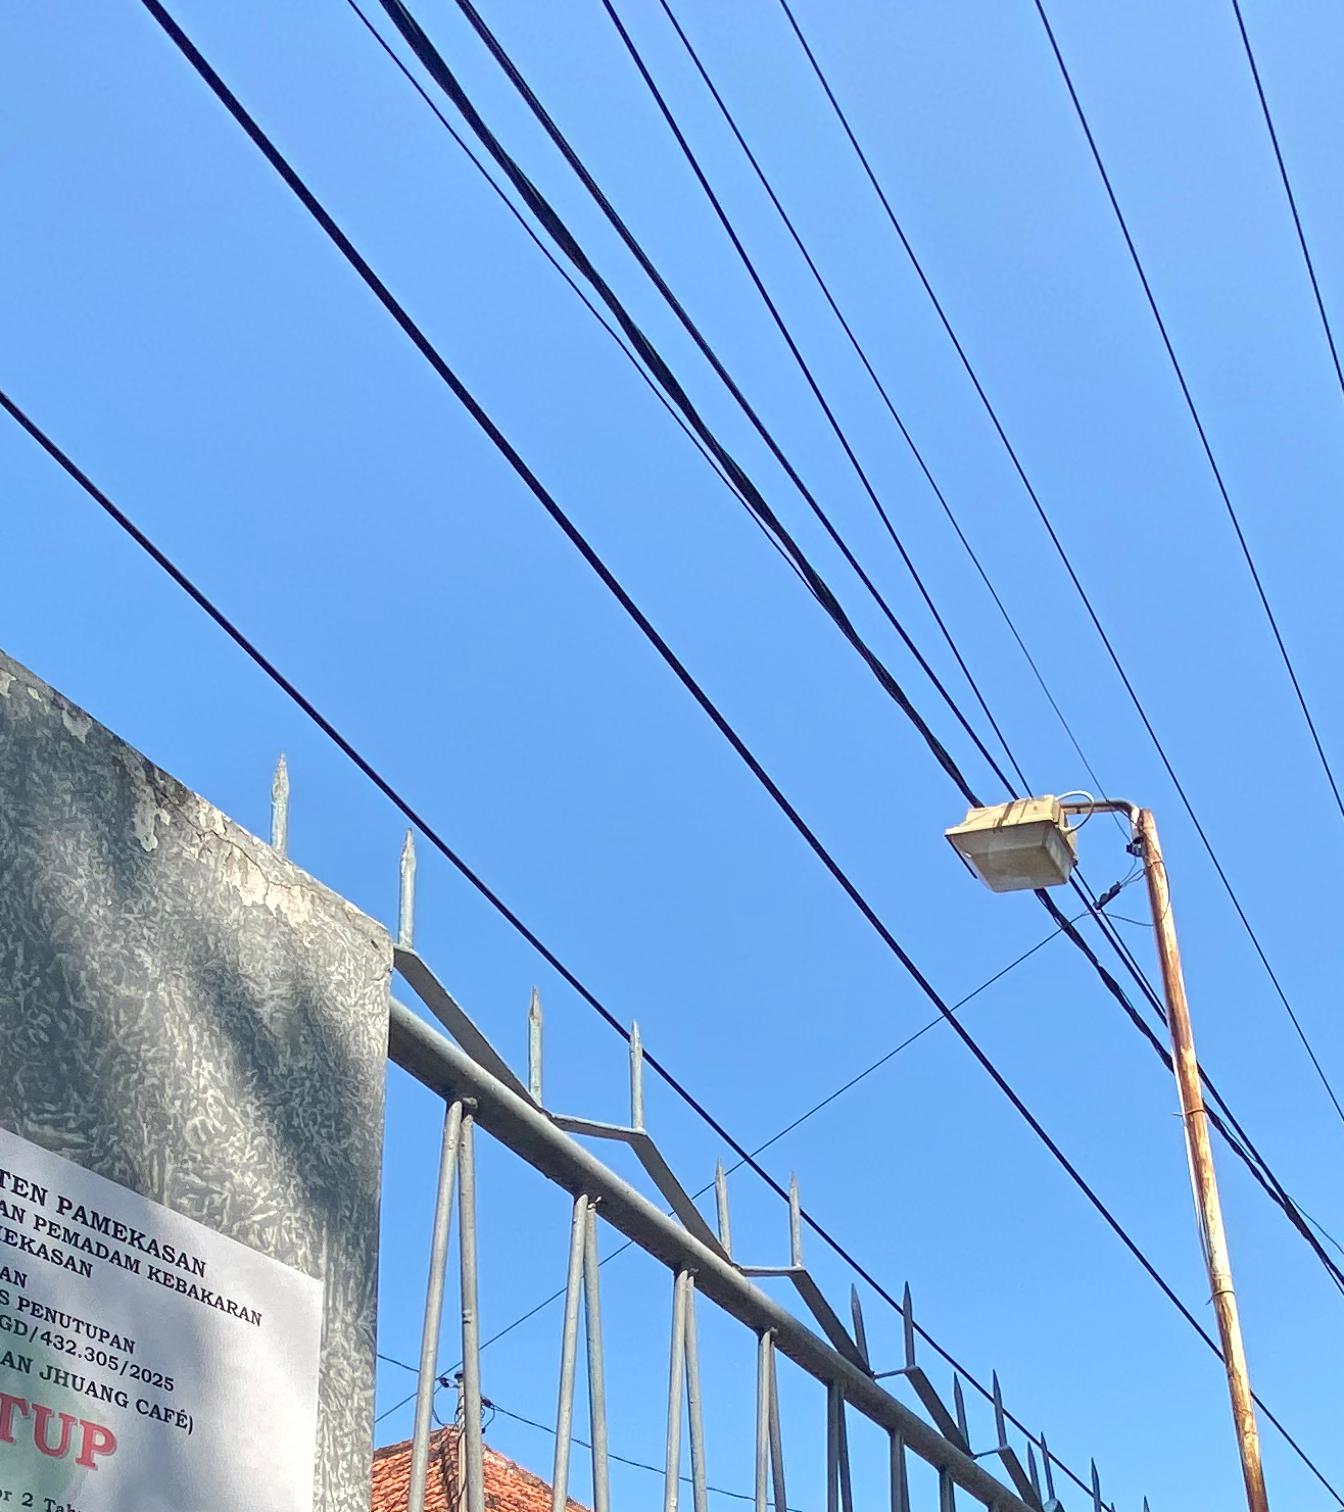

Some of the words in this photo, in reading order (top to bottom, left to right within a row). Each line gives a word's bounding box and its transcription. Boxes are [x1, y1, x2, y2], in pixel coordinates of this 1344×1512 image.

[32, 1213, 142, 1275] PEMADAM
[146, 1264, 263, 1327] KEBAKARAN
[55, 1194, 207, 1279] PAMEKASAN
[14, 1295, 136, 1355] PENUTUPAN
[38, 1364, 130, 1409] JHUANG
[135, 1398, 194, 1436] CAFÉ)
[21, 1491, 34, 1508] 2
